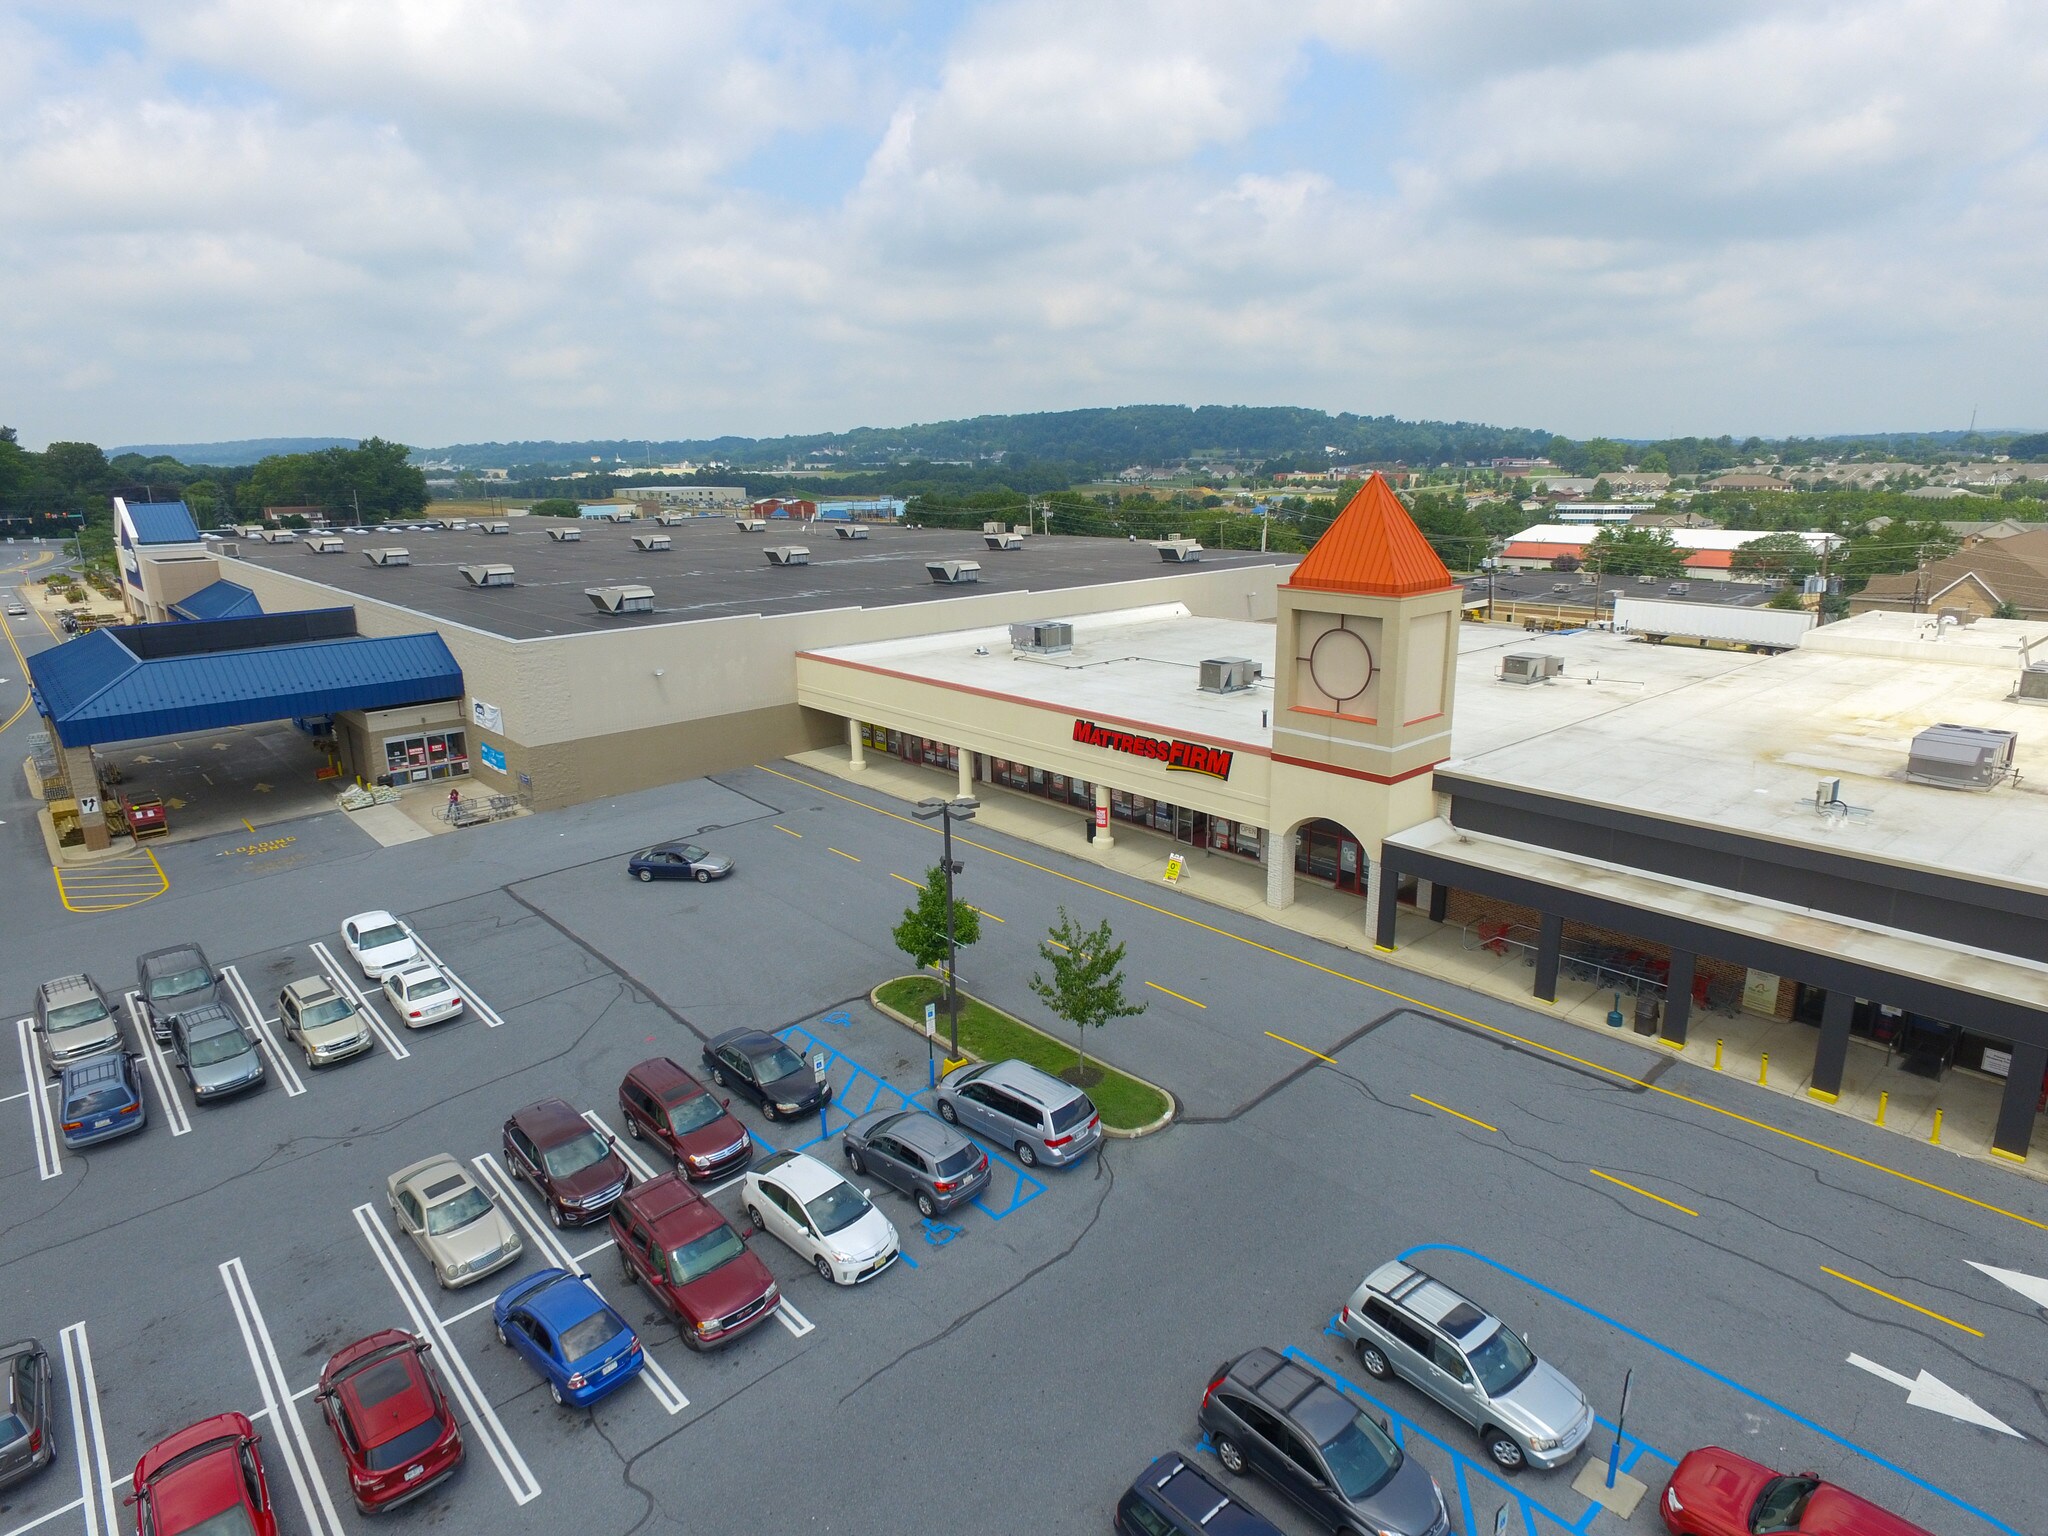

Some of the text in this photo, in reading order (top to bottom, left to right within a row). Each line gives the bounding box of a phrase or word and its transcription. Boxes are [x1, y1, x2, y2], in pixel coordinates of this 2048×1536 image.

[1240, 825, 1257, 836] OPEN
[224, 836, 297, 856] LOADING
[247, 843, 290, 856] ZONE
